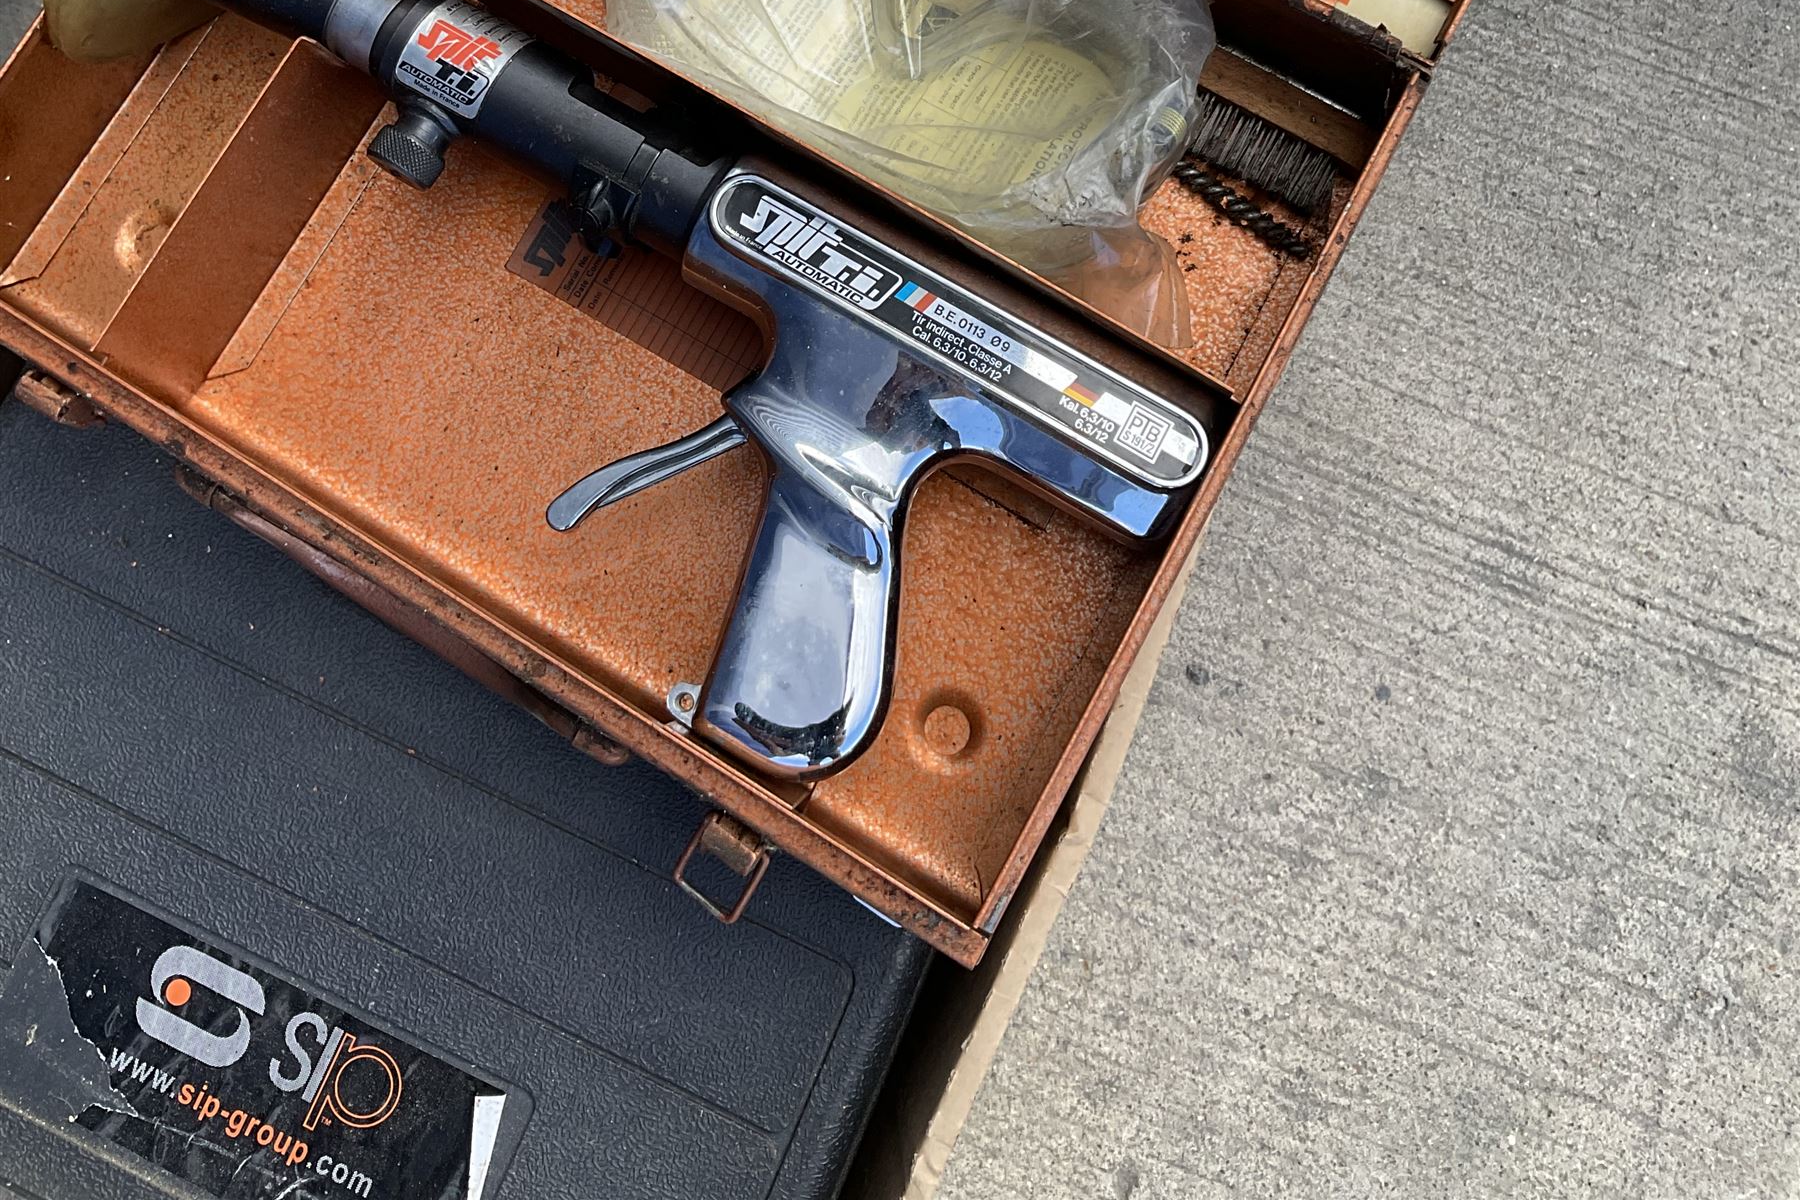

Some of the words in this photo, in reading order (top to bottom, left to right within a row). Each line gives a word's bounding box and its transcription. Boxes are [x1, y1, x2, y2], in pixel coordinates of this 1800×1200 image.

[401, 63, 469, 104] AUTOMATIC
[413, 79, 431, 94] Made
[431, 89, 440, 98] in
[439, 92, 460, 109] France
[562, 269, 580, 291] Serial
[573, 278, 589, 298] Date
[771, 249, 864, 304] AUTOMATIC
[911, 324, 934, 343] Cal.
[933, 303, 959, 324] B.E.
[957, 316, 986, 339] 0113
[909, 310, 927, 326] Tir
[1002, 362, 1014, 375] A
[1057, 395, 1081, 414] Kal.
[1077, 407, 1116, 434] 6,3/10
[1127, 410, 1165, 444] PTB
[109, 1046, 374, 1199] www.sip-group.com
